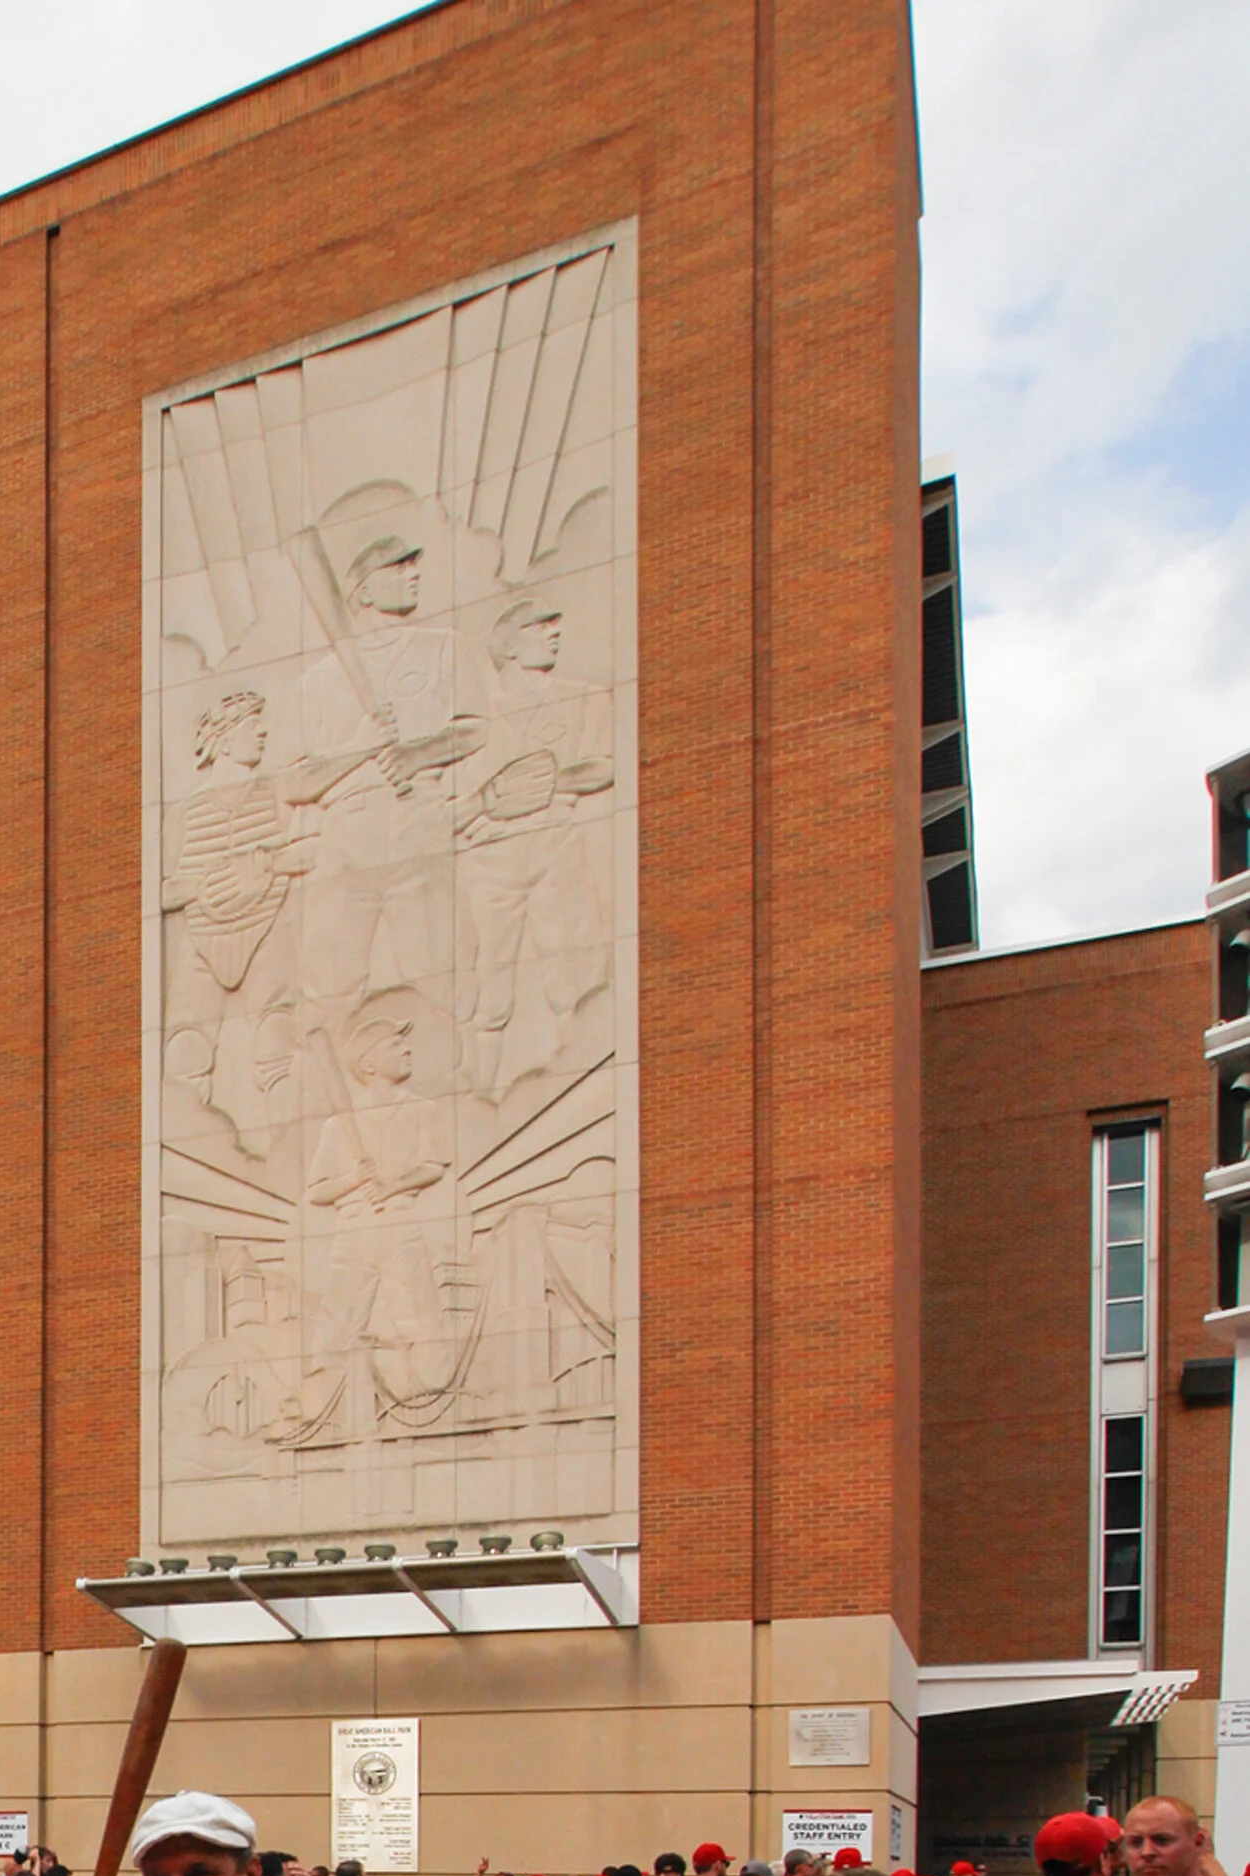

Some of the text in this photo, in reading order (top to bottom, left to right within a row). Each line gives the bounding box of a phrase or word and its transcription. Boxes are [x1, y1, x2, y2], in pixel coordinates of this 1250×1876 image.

[788, 1822, 867, 1831] CREDENTIALED
[793, 1832, 862, 1840] STAFF ENTRY
[5, 1841, 10, 1849] C
